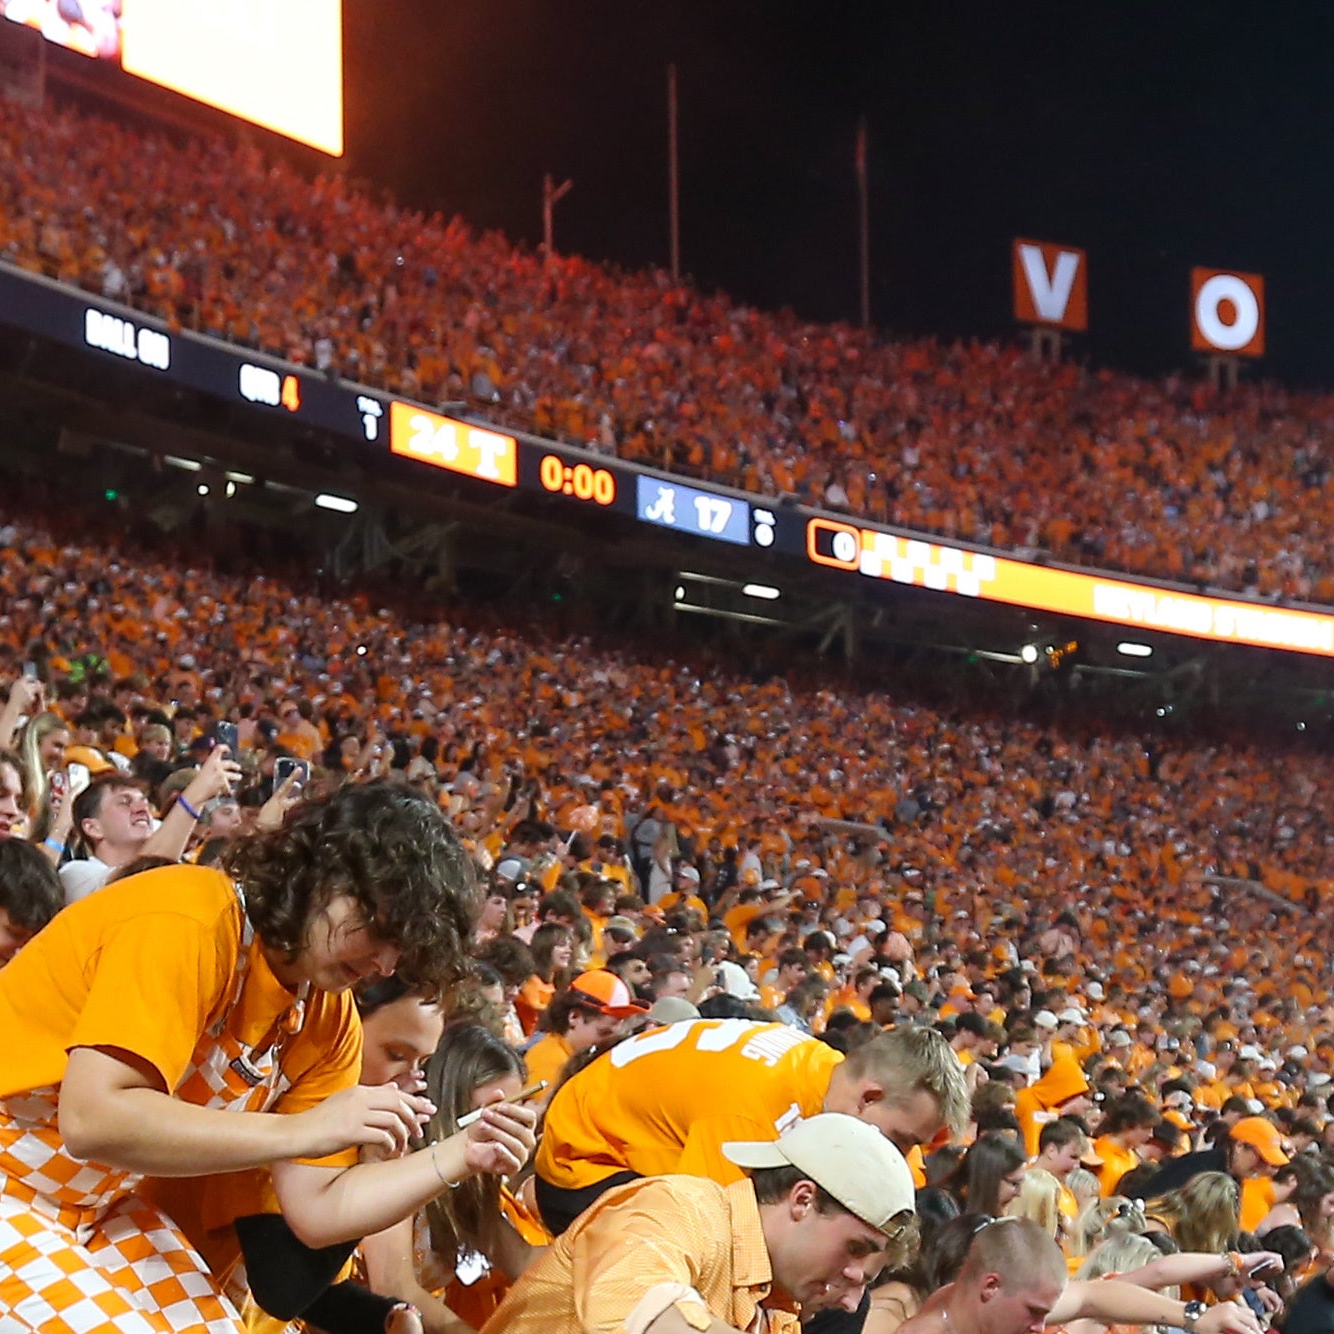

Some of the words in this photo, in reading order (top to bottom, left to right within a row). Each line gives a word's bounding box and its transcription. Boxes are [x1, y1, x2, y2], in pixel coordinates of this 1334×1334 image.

[408, 413, 460, 463] 24
[468, 428, 507, 480] T
[540, 454, 616, 507] 0:00
[693, 495, 733, 534] 17
